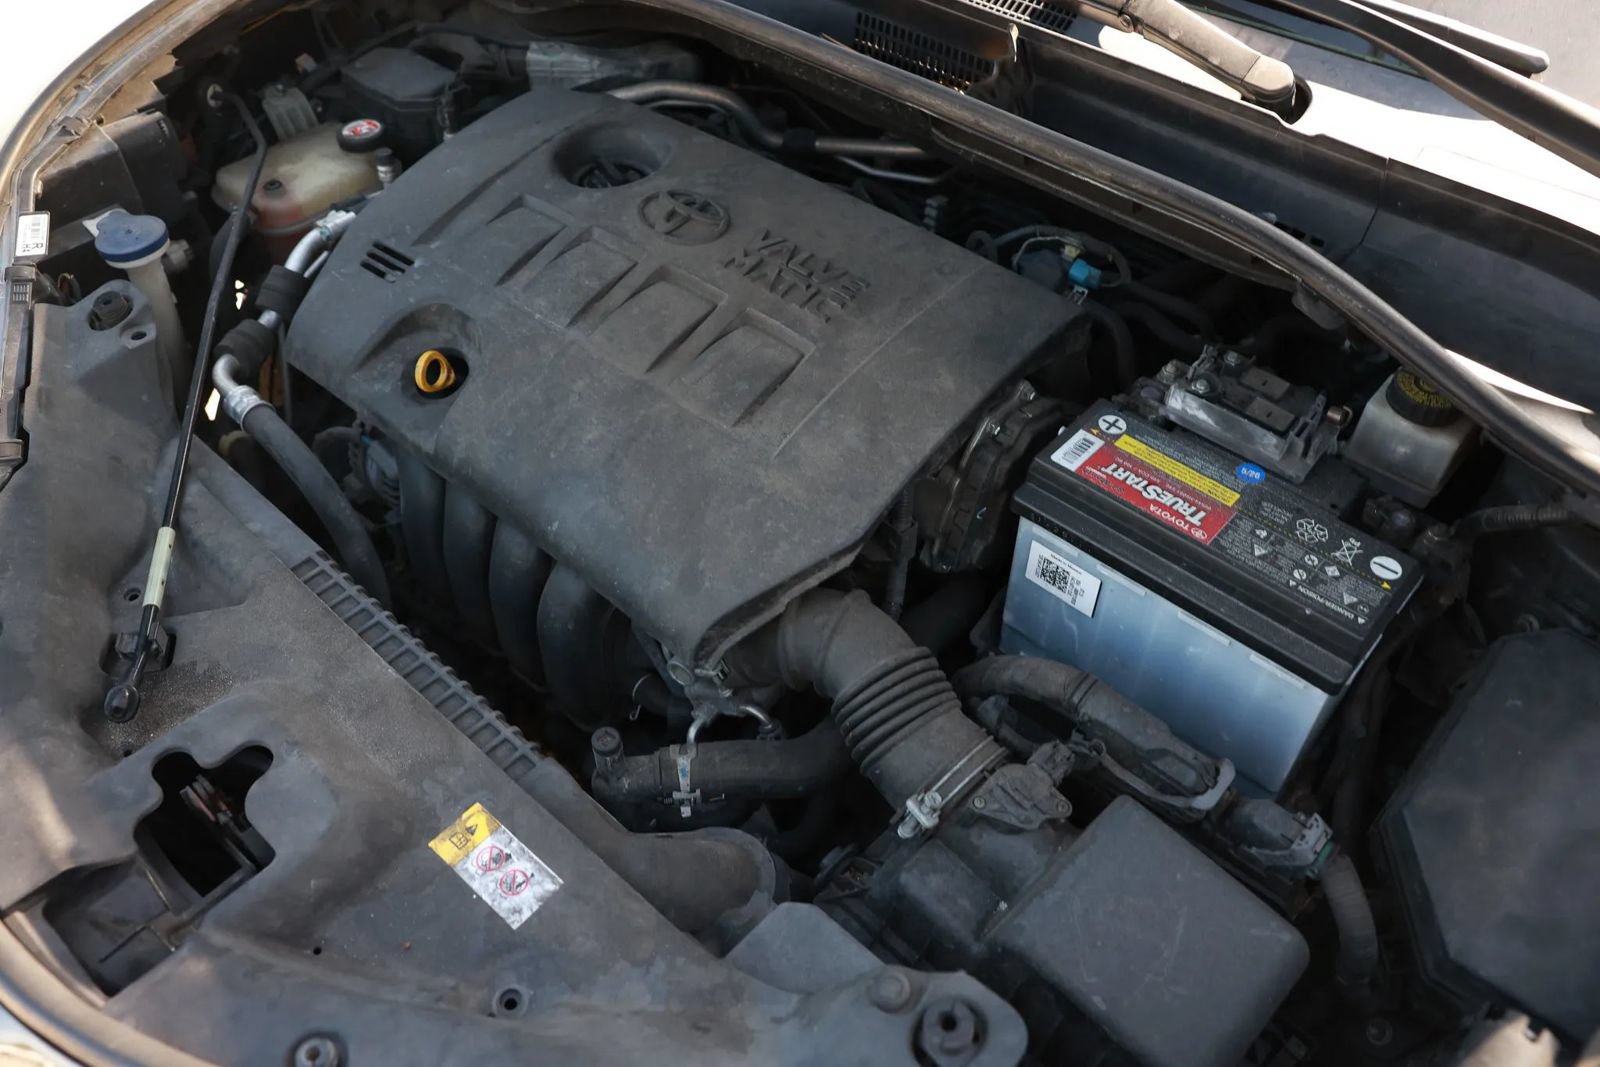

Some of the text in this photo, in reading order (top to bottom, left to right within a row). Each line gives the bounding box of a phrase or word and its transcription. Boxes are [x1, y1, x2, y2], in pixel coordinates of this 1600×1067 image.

[756, 229, 871, 300] VALVE
[723, 247, 846, 324] MATIC
[1150, 503, 1190, 530] TOYOTA
[1348, 537, 1361, 547] Pb
[1298, 585, 1355, 619] DANGER/POISON
